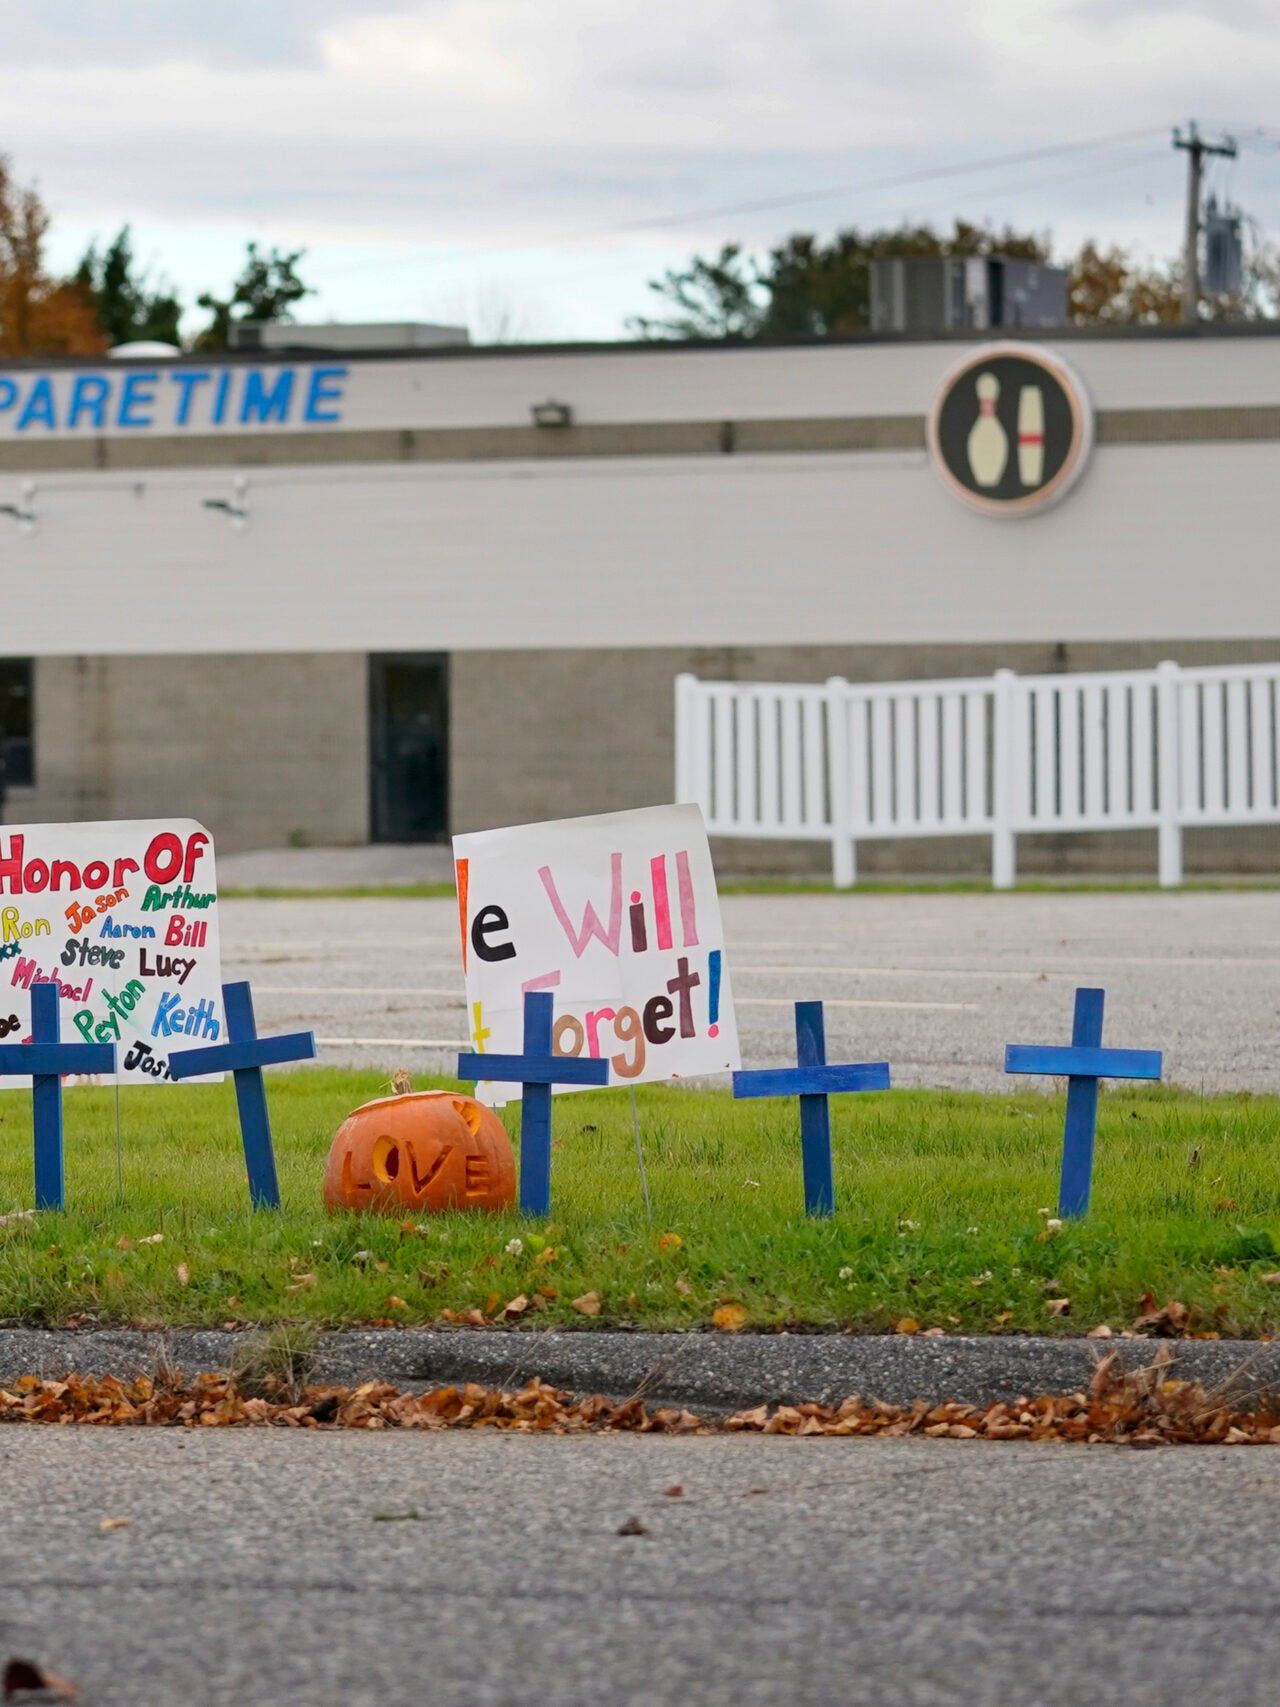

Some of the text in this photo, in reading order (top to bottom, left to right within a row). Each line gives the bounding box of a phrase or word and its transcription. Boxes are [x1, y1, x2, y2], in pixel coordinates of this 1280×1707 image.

[144, 832, 210, 884] Of
[64, 888, 130, 934] Jason
[141, 884, 217, 912] Arthur
[538, 851, 700, 959] Will
[1, 906, 52, 943] Ron
[99, 915, 157, 939] Aaron
[164, 915, 208, 948] Bill
[60, 937, 126, 970] Steve
[139, 948, 197, 985] Lucy
[73, 978, 146, 1044] Peyton
[151, 992, 221, 1041] Keith
[342, 1134, 490, 1197] LOVE
